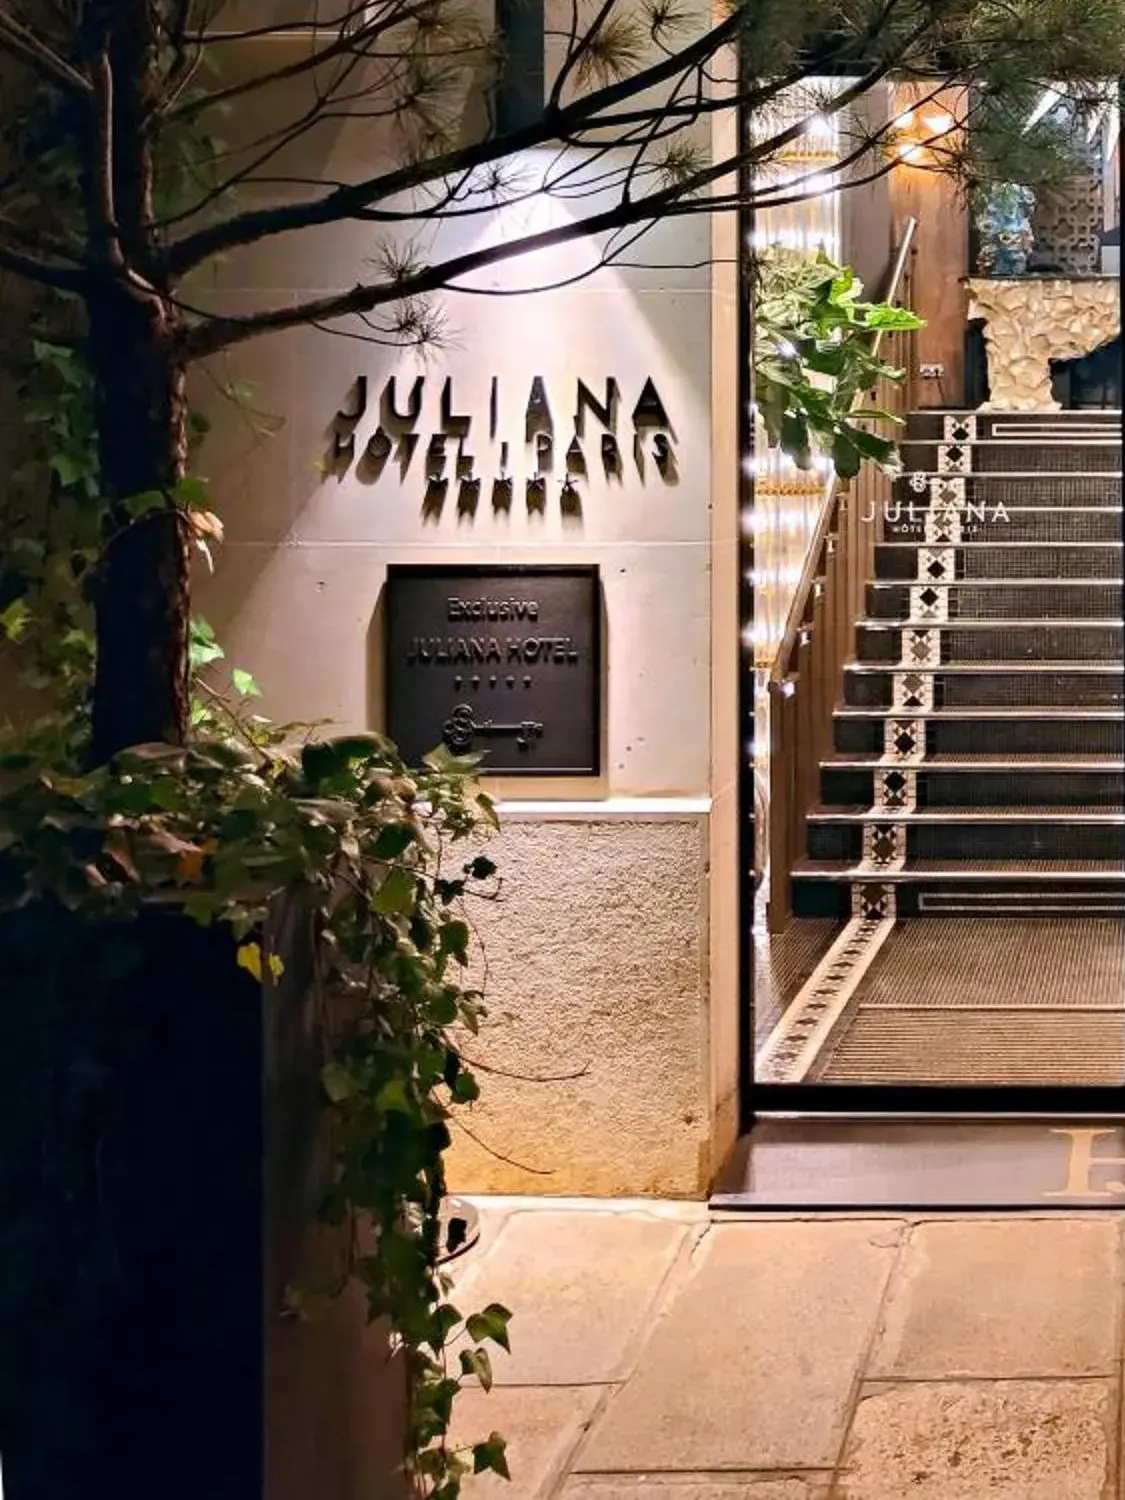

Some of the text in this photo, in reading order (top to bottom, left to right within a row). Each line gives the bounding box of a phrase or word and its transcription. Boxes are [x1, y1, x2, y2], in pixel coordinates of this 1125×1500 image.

[336, 375, 673, 426] JULIANA
[536, 433, 671, 462] PARIS
[860, 500, 1011, 523] JULANA
[447, 596, 539, 621] Exclusive
[406, 636, 579, 663] JULIANA HOTEL
